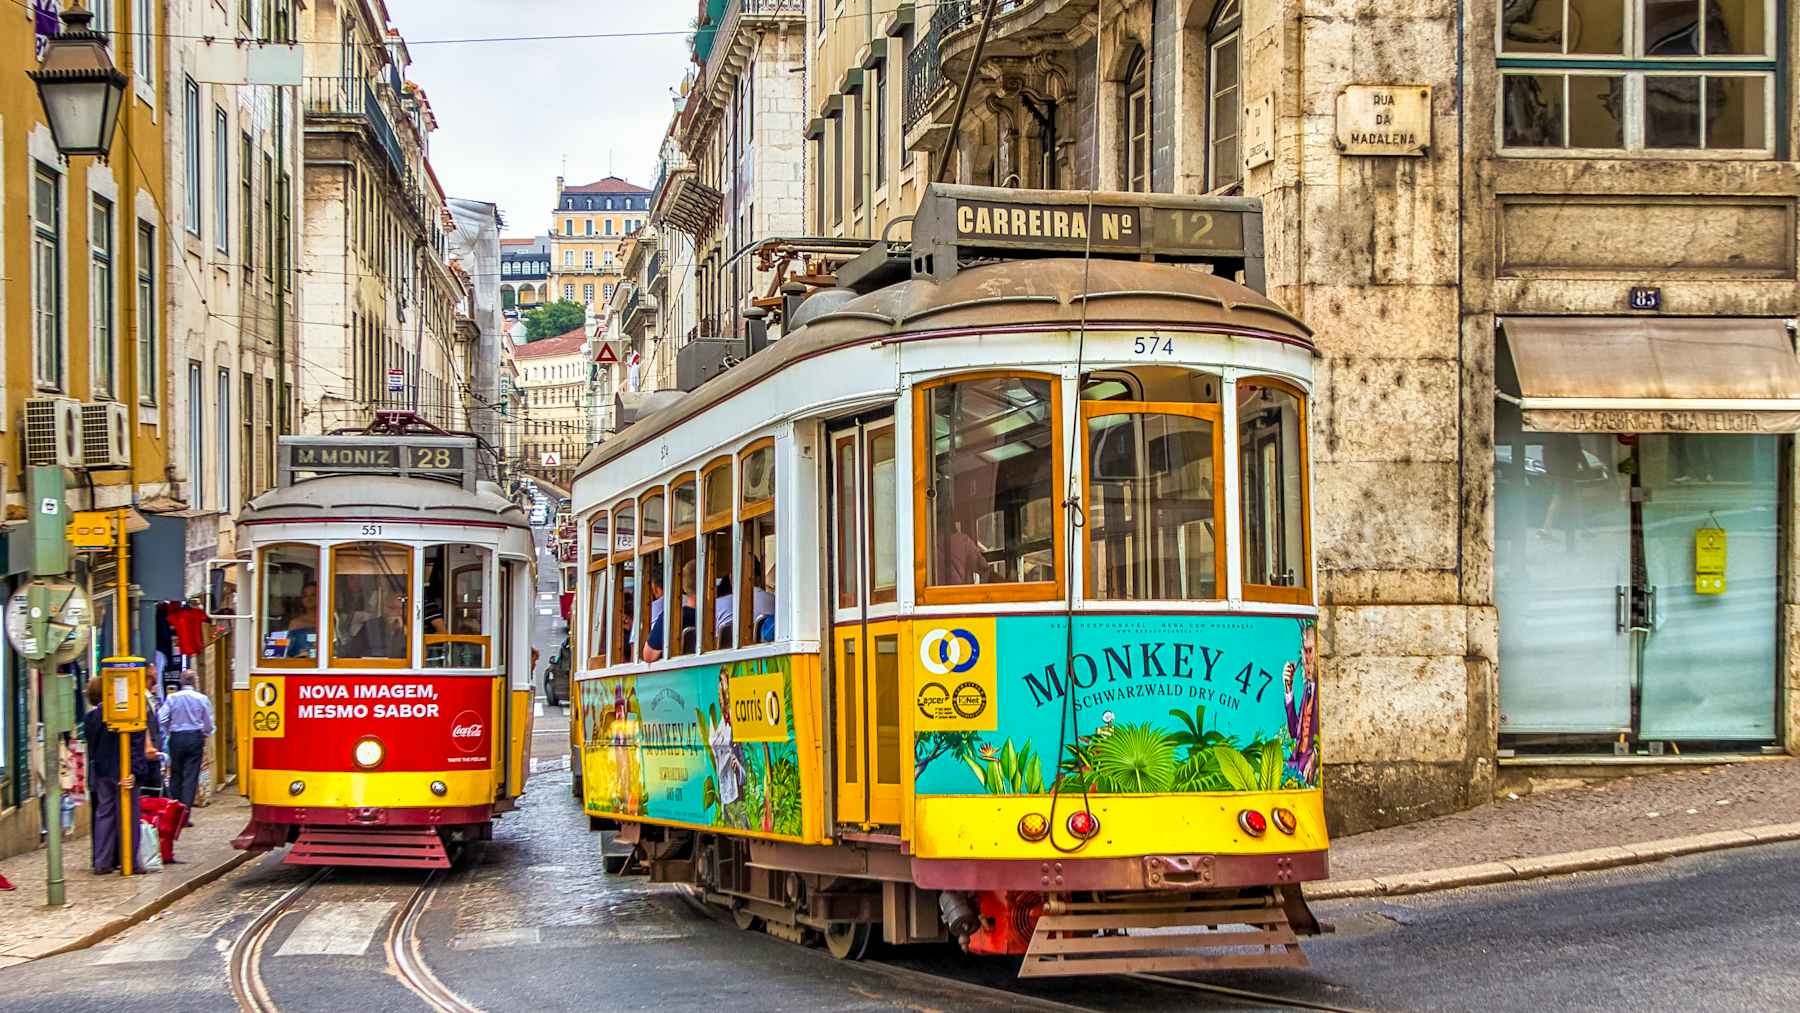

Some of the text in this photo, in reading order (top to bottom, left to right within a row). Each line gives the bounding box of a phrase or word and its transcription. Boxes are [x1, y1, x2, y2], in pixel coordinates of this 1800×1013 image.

[1373, 95, 1395, 106] RUA
[1376, 114, 1392, 125] DA
[1351, 133, 1416, 145] MADALENA
[957, 205, 1088, 239] CARREIRA
[1170, 211, 1215, 247] 12
[1134, 336, 1175, 355] 574
[417, 448, 450, 468] 28
[361, 525, 383, 536] 551
[1021, 642, 1273, 709] MONKEY 47
[299, 684, 438, 700] NOVA IMAGEM,
[1073, 684, 1241, 712] SCHWARZWALD DRY GIN
[298, 703, 440, 719] MESMO SABOR
[735, 689, 763, 722] carris
